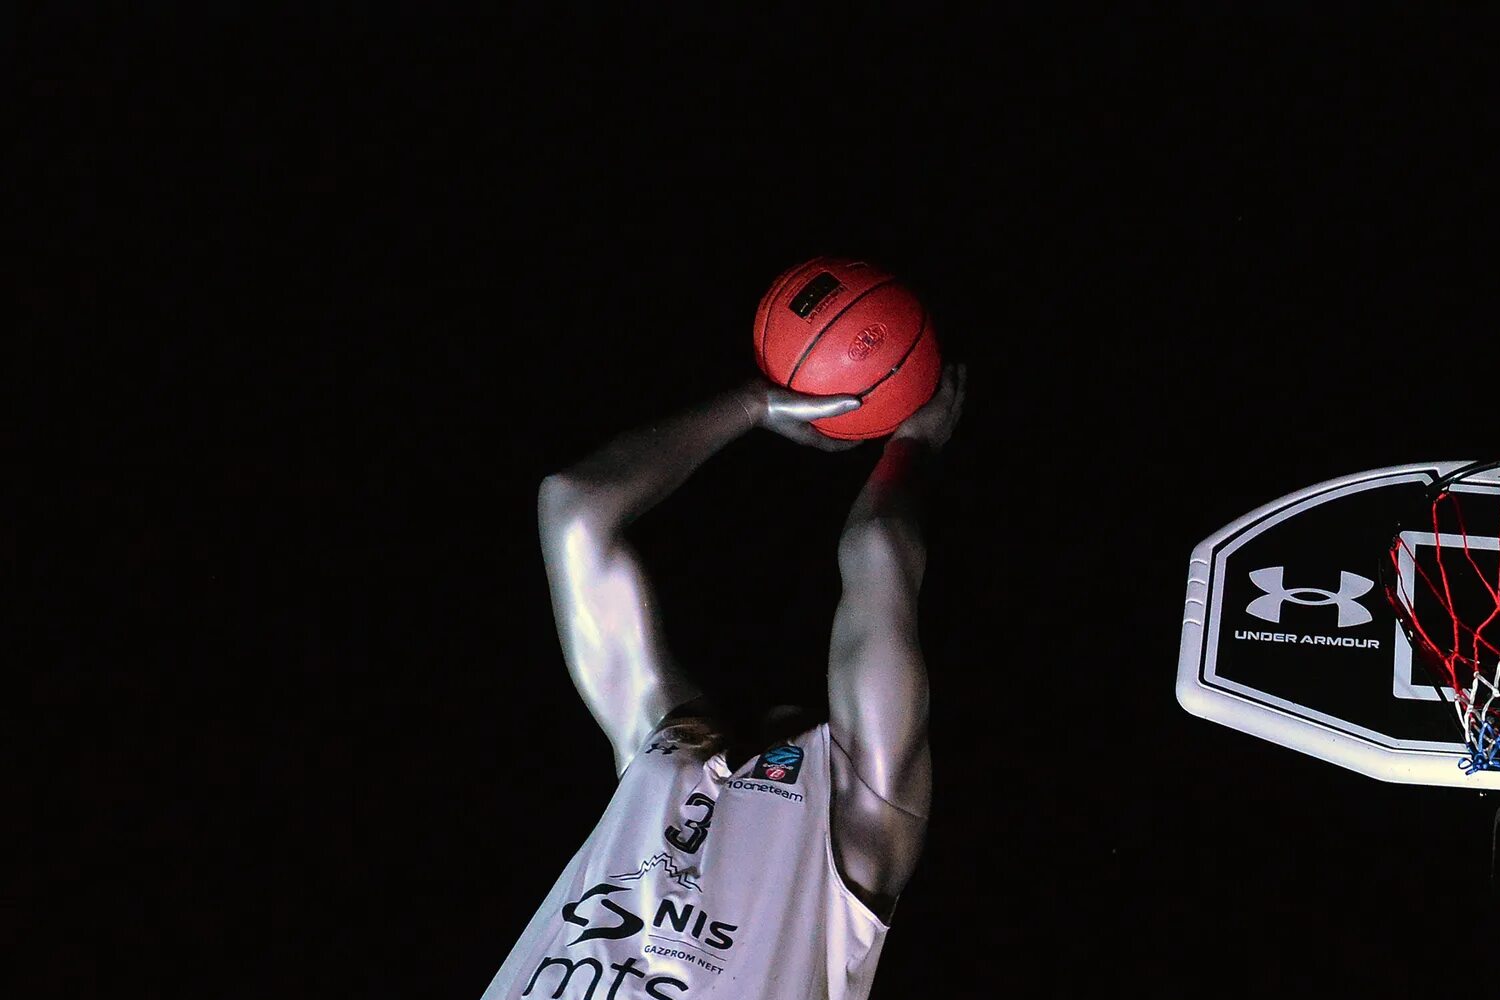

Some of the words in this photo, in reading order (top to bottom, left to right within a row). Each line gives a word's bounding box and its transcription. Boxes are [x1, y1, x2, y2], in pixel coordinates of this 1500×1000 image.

[1234, 630, 1297, 644] UNDER
[1300, 634, 1380, 649] ARMOUR
[664, 792, 716, 854] 3
[652, 899, 738, 950] NIS
[644, 945, 696, 964] GAZPROM
[697, 959, 724, 976] NEFT
